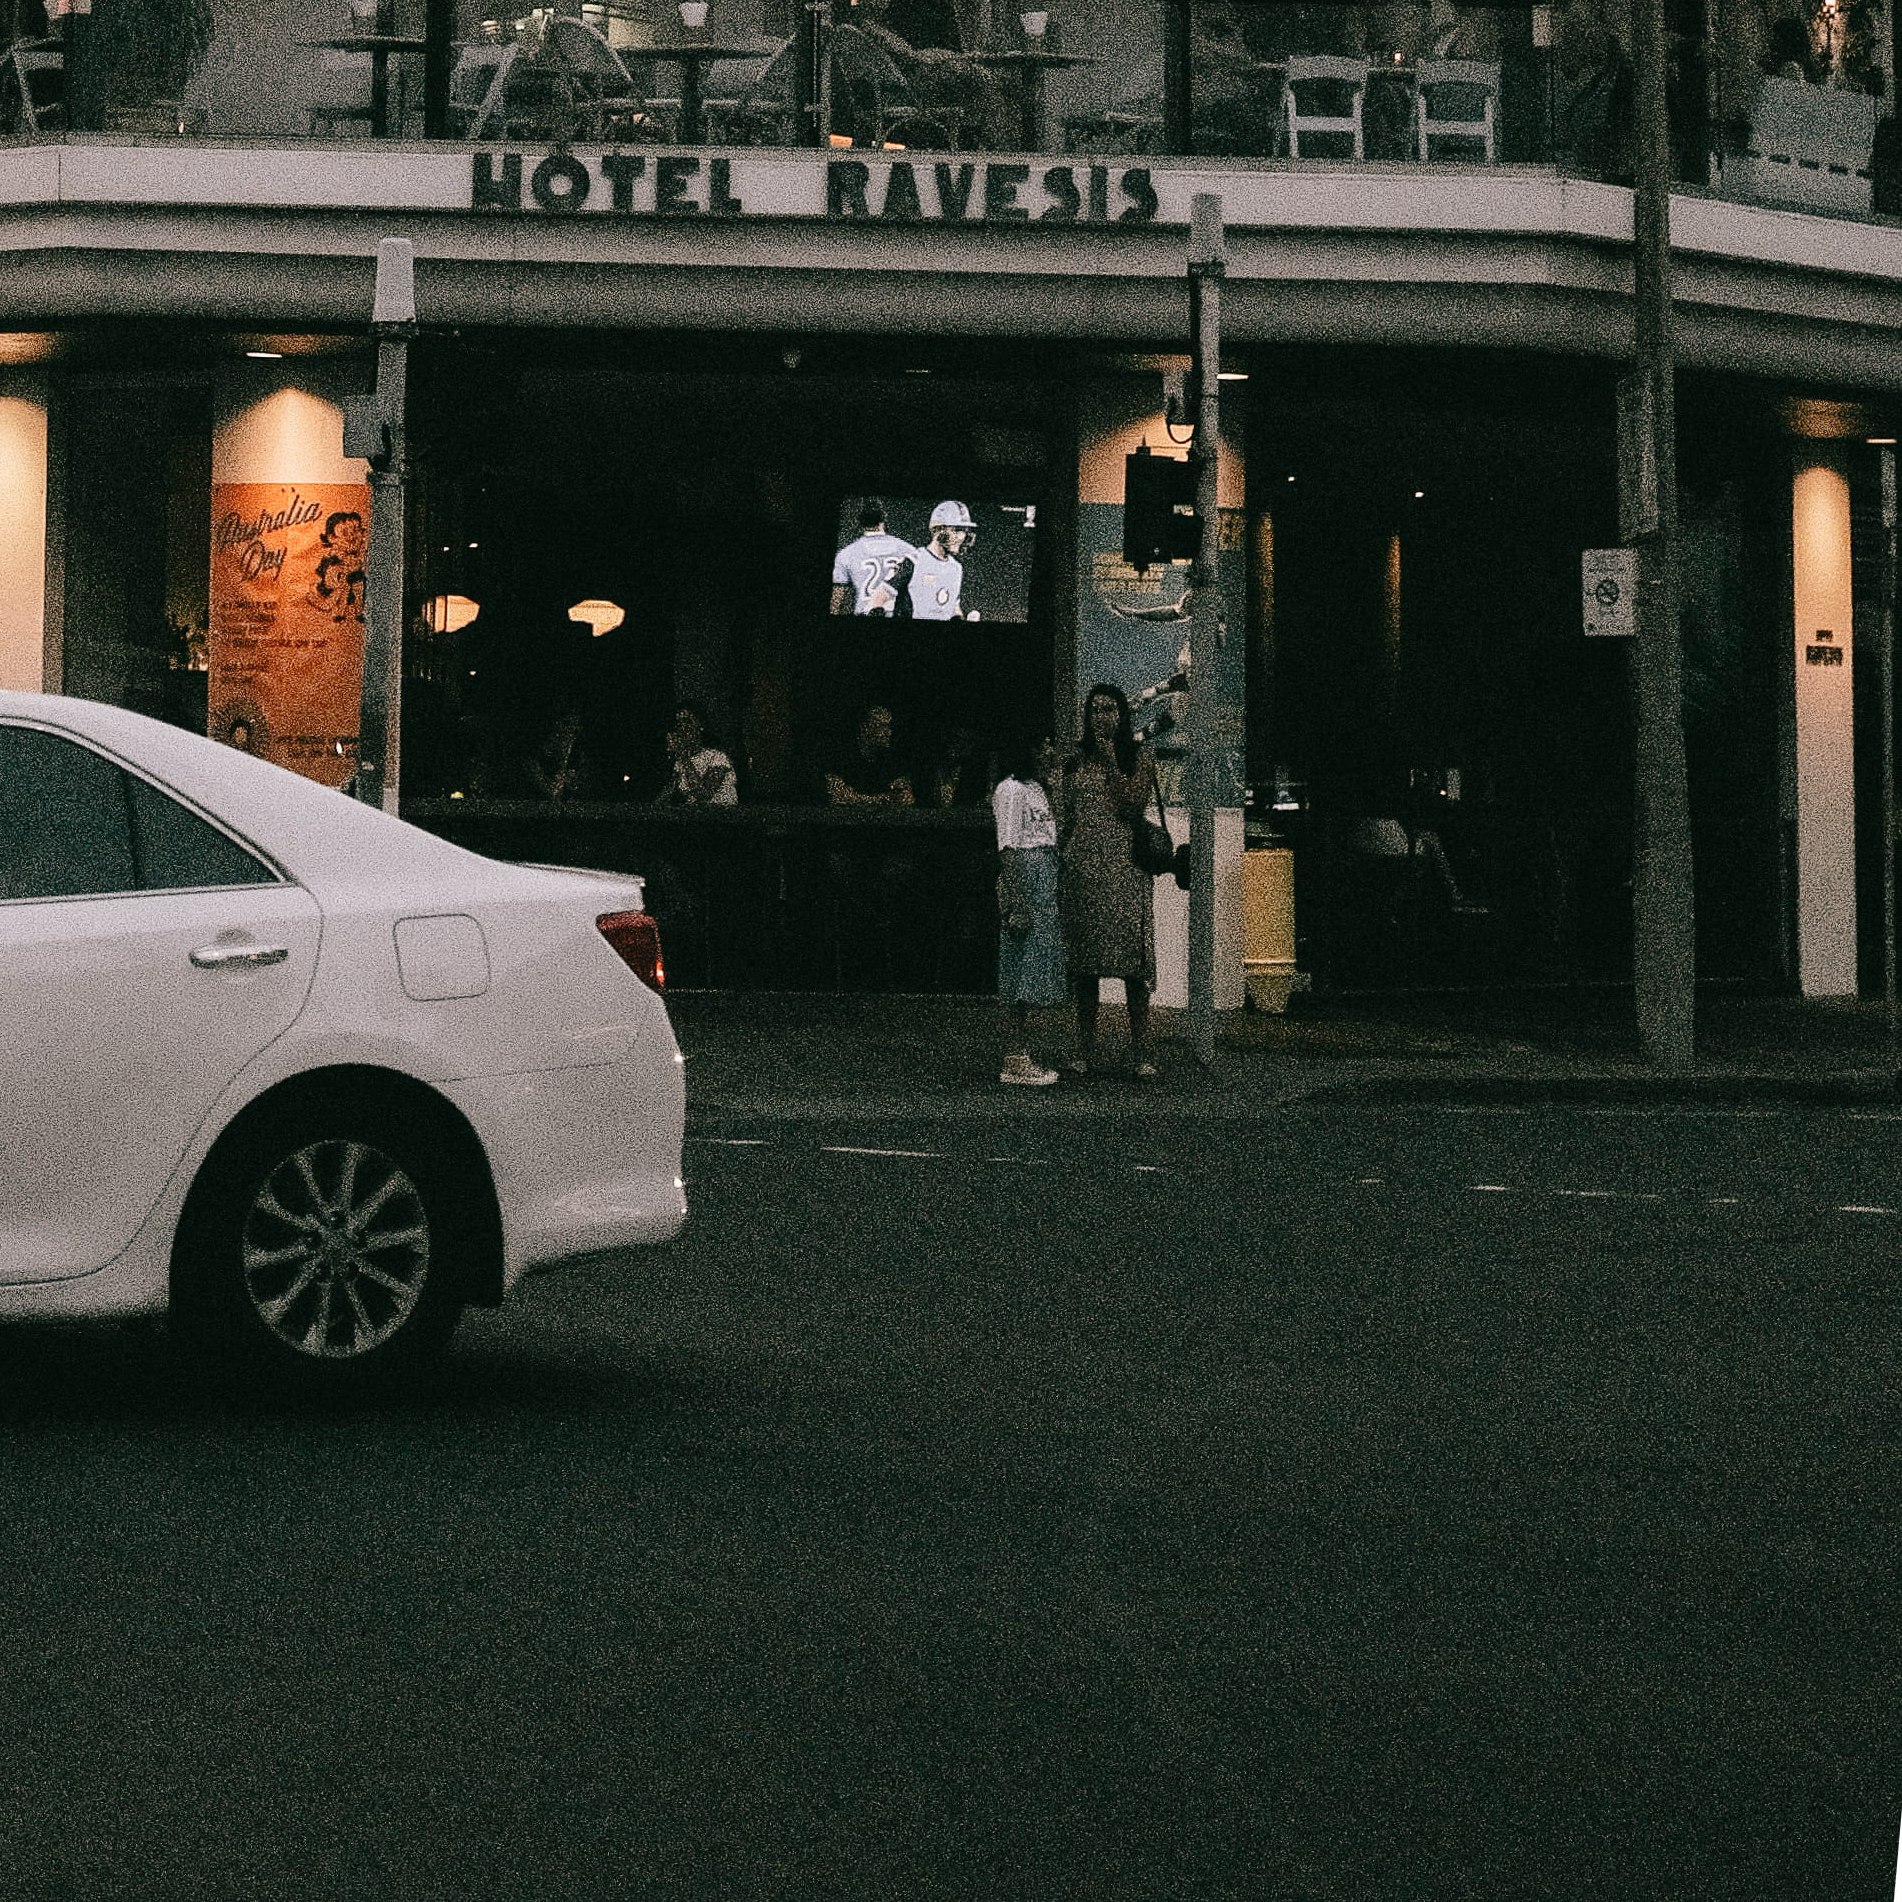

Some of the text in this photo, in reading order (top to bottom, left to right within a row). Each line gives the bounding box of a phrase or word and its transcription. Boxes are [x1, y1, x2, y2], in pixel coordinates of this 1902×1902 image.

[471, 152, 1160, 223] HOTEL RAVESIS
[216, 494, 323, 551] Australia
[240, 539, 288, 582] Day
